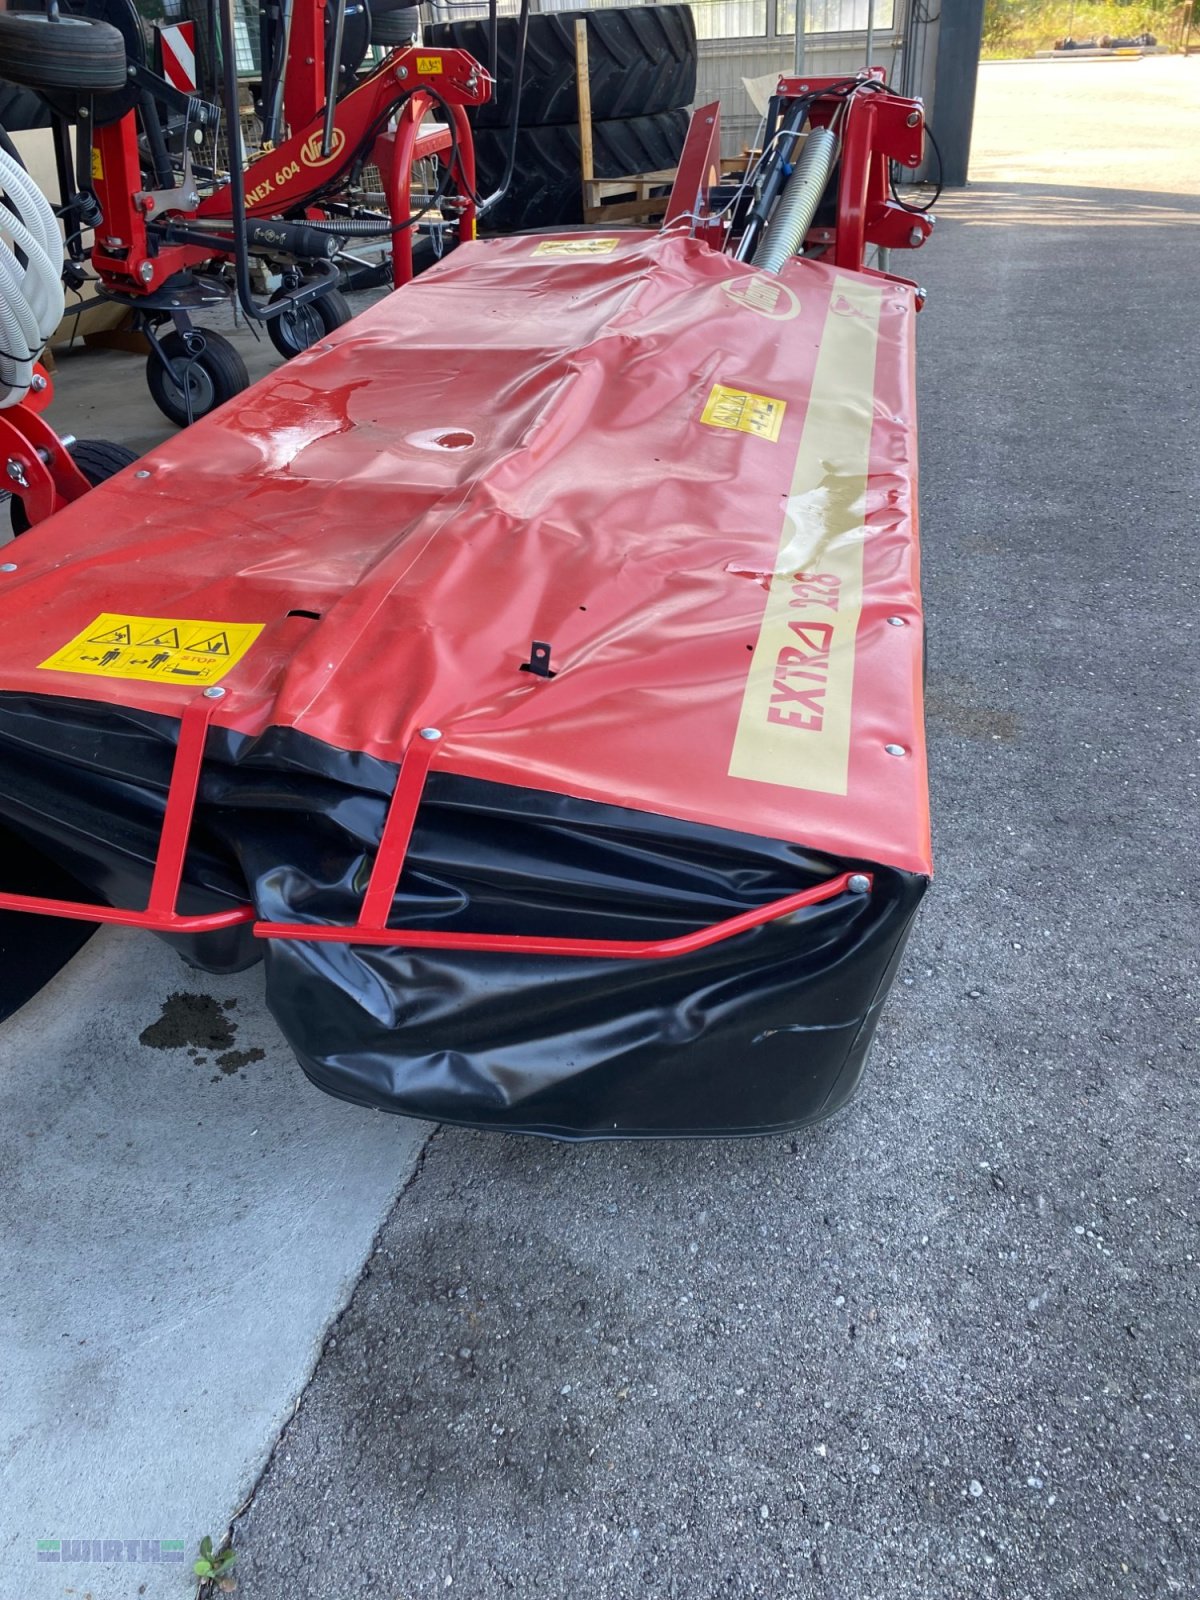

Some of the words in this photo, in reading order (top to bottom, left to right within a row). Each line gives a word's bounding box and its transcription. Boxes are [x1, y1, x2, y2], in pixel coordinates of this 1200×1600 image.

[275, 160, 300, 185] 604
[788, 573, 842, 612] 228
[180, 655, 217, 664] STOP
[767, 620, 834, 732] EXTRA
